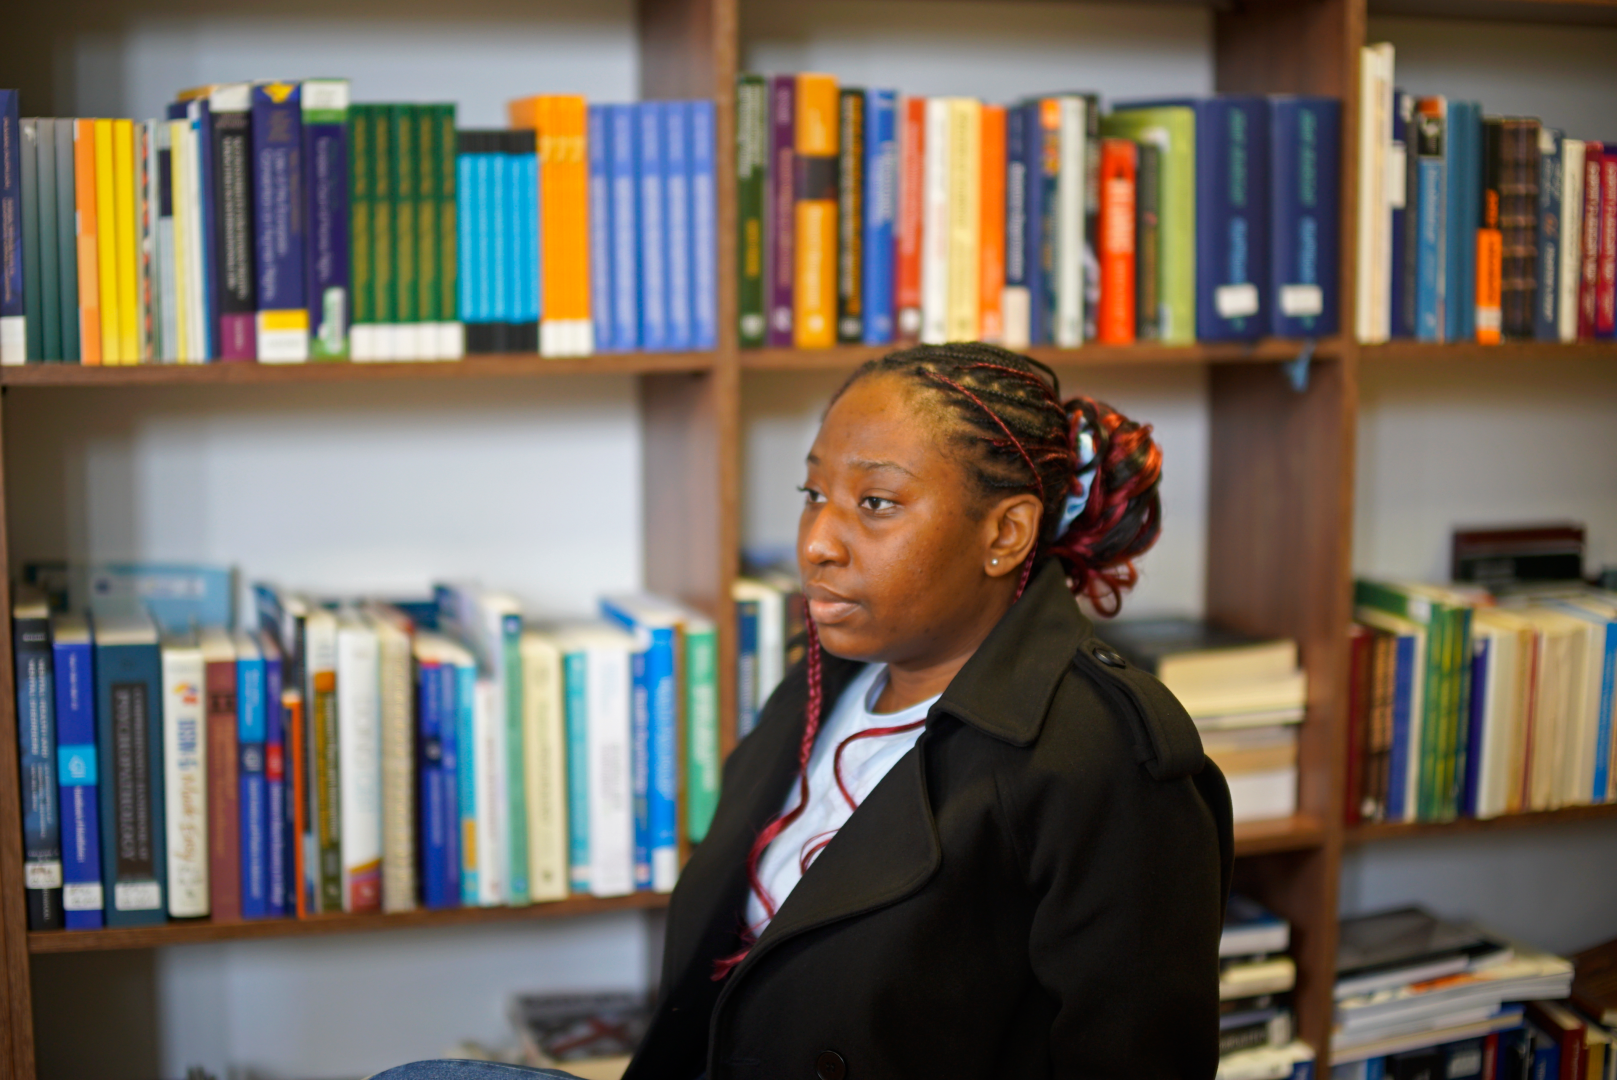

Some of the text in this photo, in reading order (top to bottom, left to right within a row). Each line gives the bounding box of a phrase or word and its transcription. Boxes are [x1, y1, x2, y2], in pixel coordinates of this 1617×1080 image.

[116, 690, 135, 861] PSYCHOPATHOLOGY
[179, 773, 199, 818] Made
[174, 821, 200, 863] Easy
